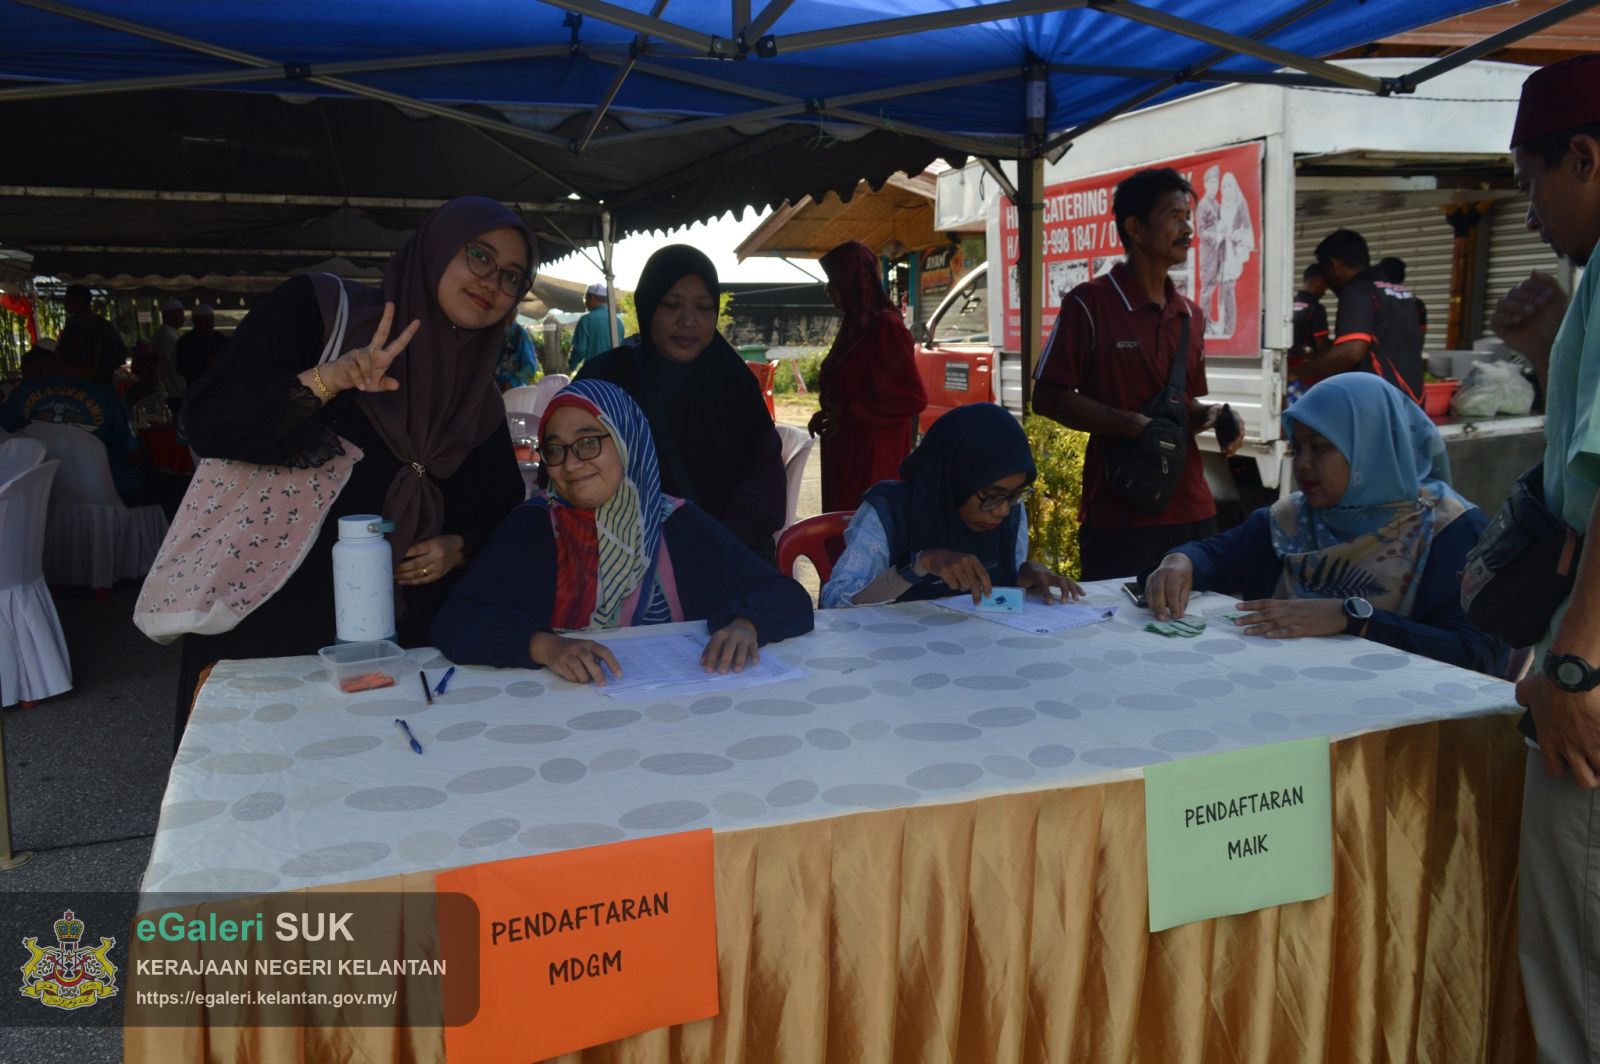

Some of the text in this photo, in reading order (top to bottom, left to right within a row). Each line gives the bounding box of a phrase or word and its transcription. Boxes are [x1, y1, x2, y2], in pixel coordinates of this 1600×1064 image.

[1043, 188, 1107, 224] CATERING
[1043, 228, 1069, 255] 3-998
[1072, 223, 1097, 251] 1847
[1185, 785, 1304, 828] PENDAFTARAN
[1227, 834, 1269, 860] MAIK
[491, 891, 669, 945] PENDAFTARAN
[549, 950, 622, 985] MDGM
